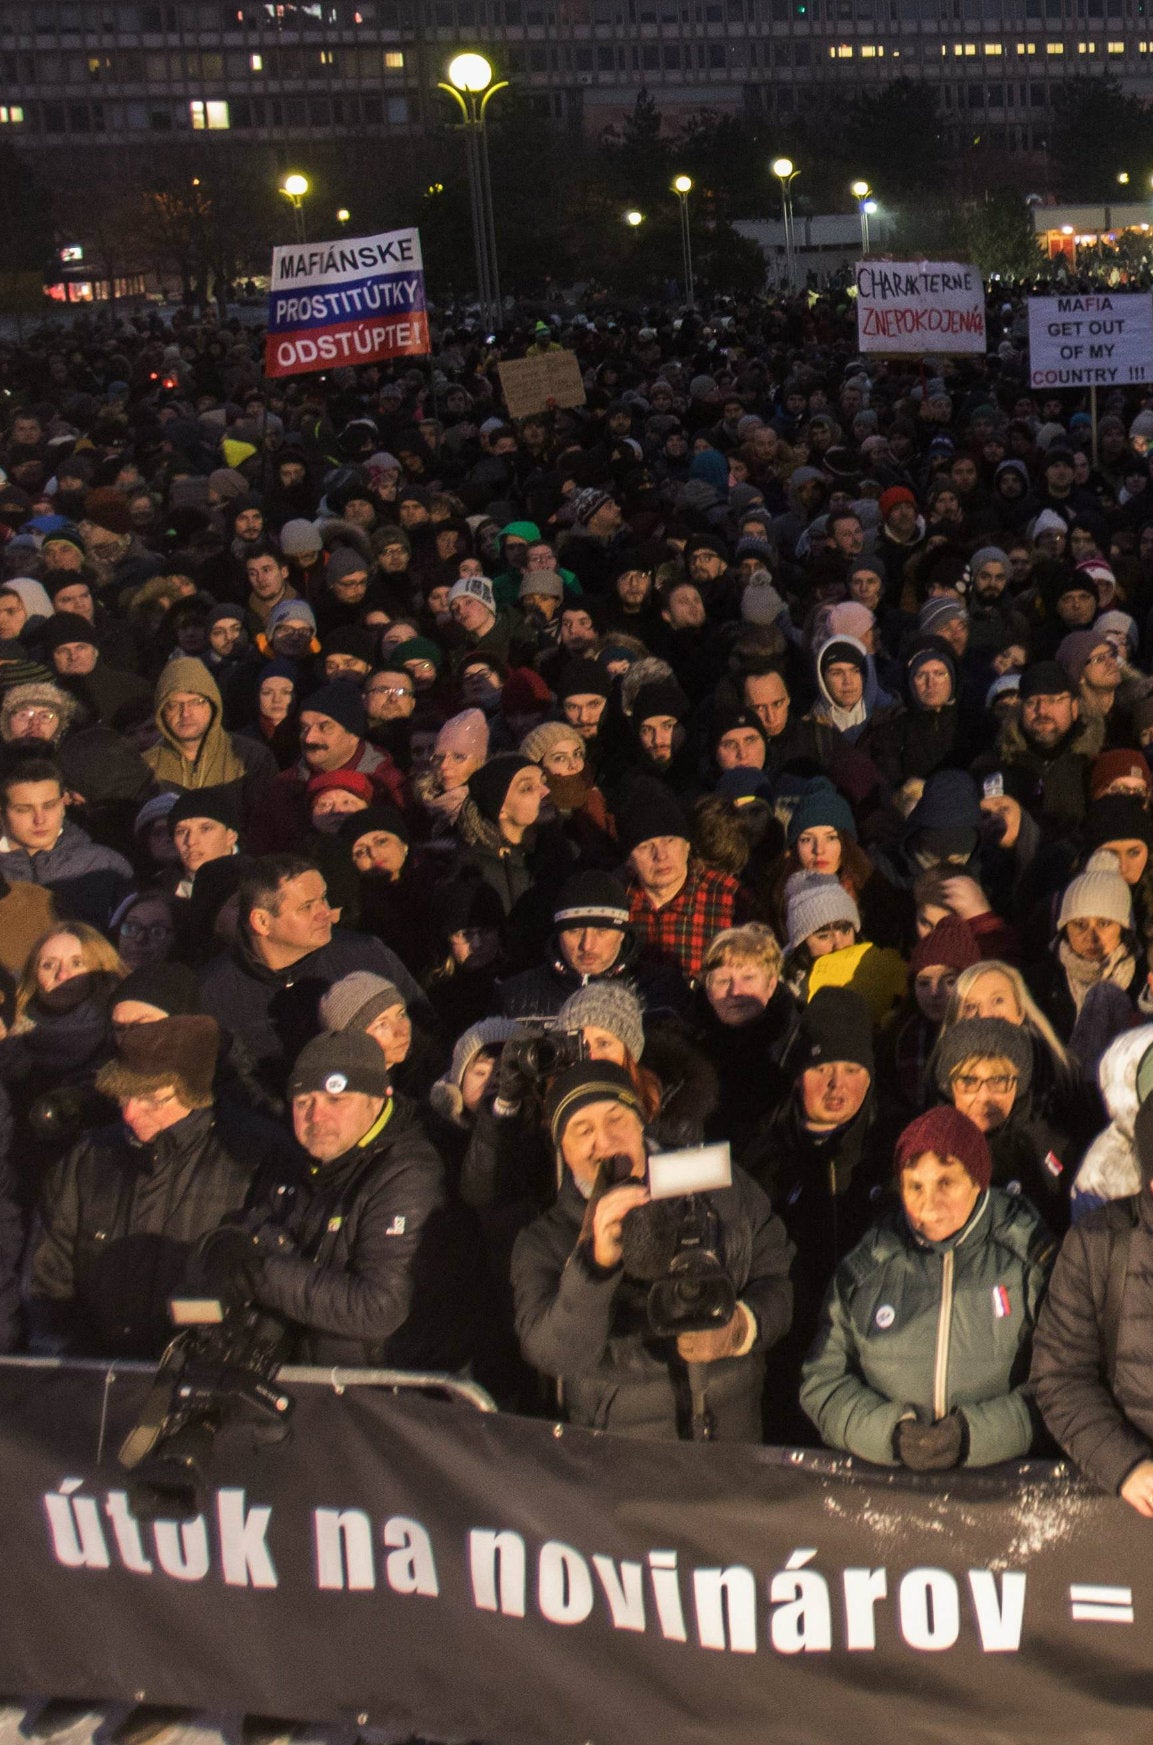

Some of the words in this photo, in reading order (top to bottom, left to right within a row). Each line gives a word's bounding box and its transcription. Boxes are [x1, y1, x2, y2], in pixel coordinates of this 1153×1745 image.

[280, 238, 414, 280] MAFIÁNSKE
[857, 268, 973, 300] CHARAKTERNE
[276, 279, 418, 324] PROSTITÚTKY
[1058, 297, 1113, 312] MAFIA
[1047, 322, 1083, 337] GET
[1089, 319, 1125, 335] OUT
[277, 323, 421, 367] ODSTÚPTE!
[1060, 344, 1084, 360] OF
[1090, 343, 1115, 359] MY
[1032, 367, 1118, 385] COUNTRY
[44, 1477, 278, 1589] útok
[314, 1507, 439, 1598] na
[468, 1528, 1027, 1655] novinárov
